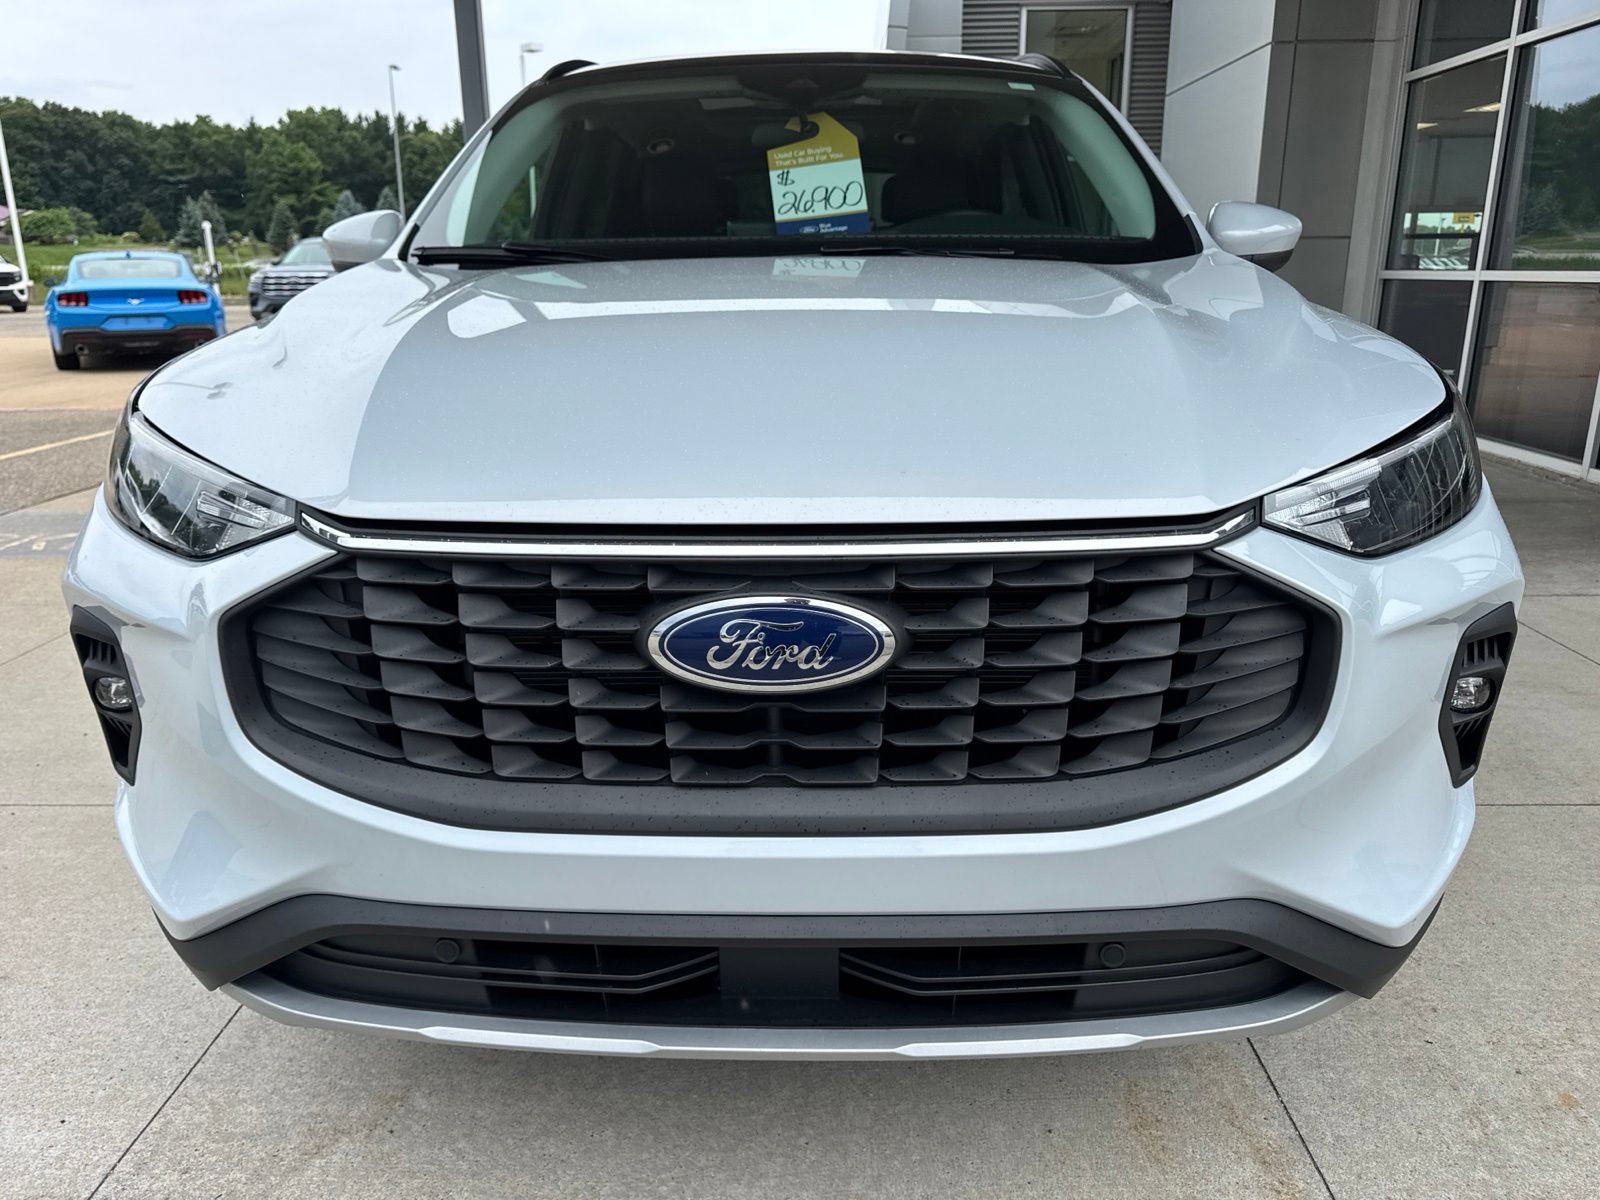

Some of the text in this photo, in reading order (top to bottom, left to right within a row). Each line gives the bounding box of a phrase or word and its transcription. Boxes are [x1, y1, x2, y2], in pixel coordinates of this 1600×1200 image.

[774, 146, 832, 160] Used Car Buying
[776, 158, 796, 167] That's
[798, 156, 815, 164] Built
[816, 154, 827, 162] For
[776, 169, 796, 187] $
[706, 618, 837, 670] Ford
